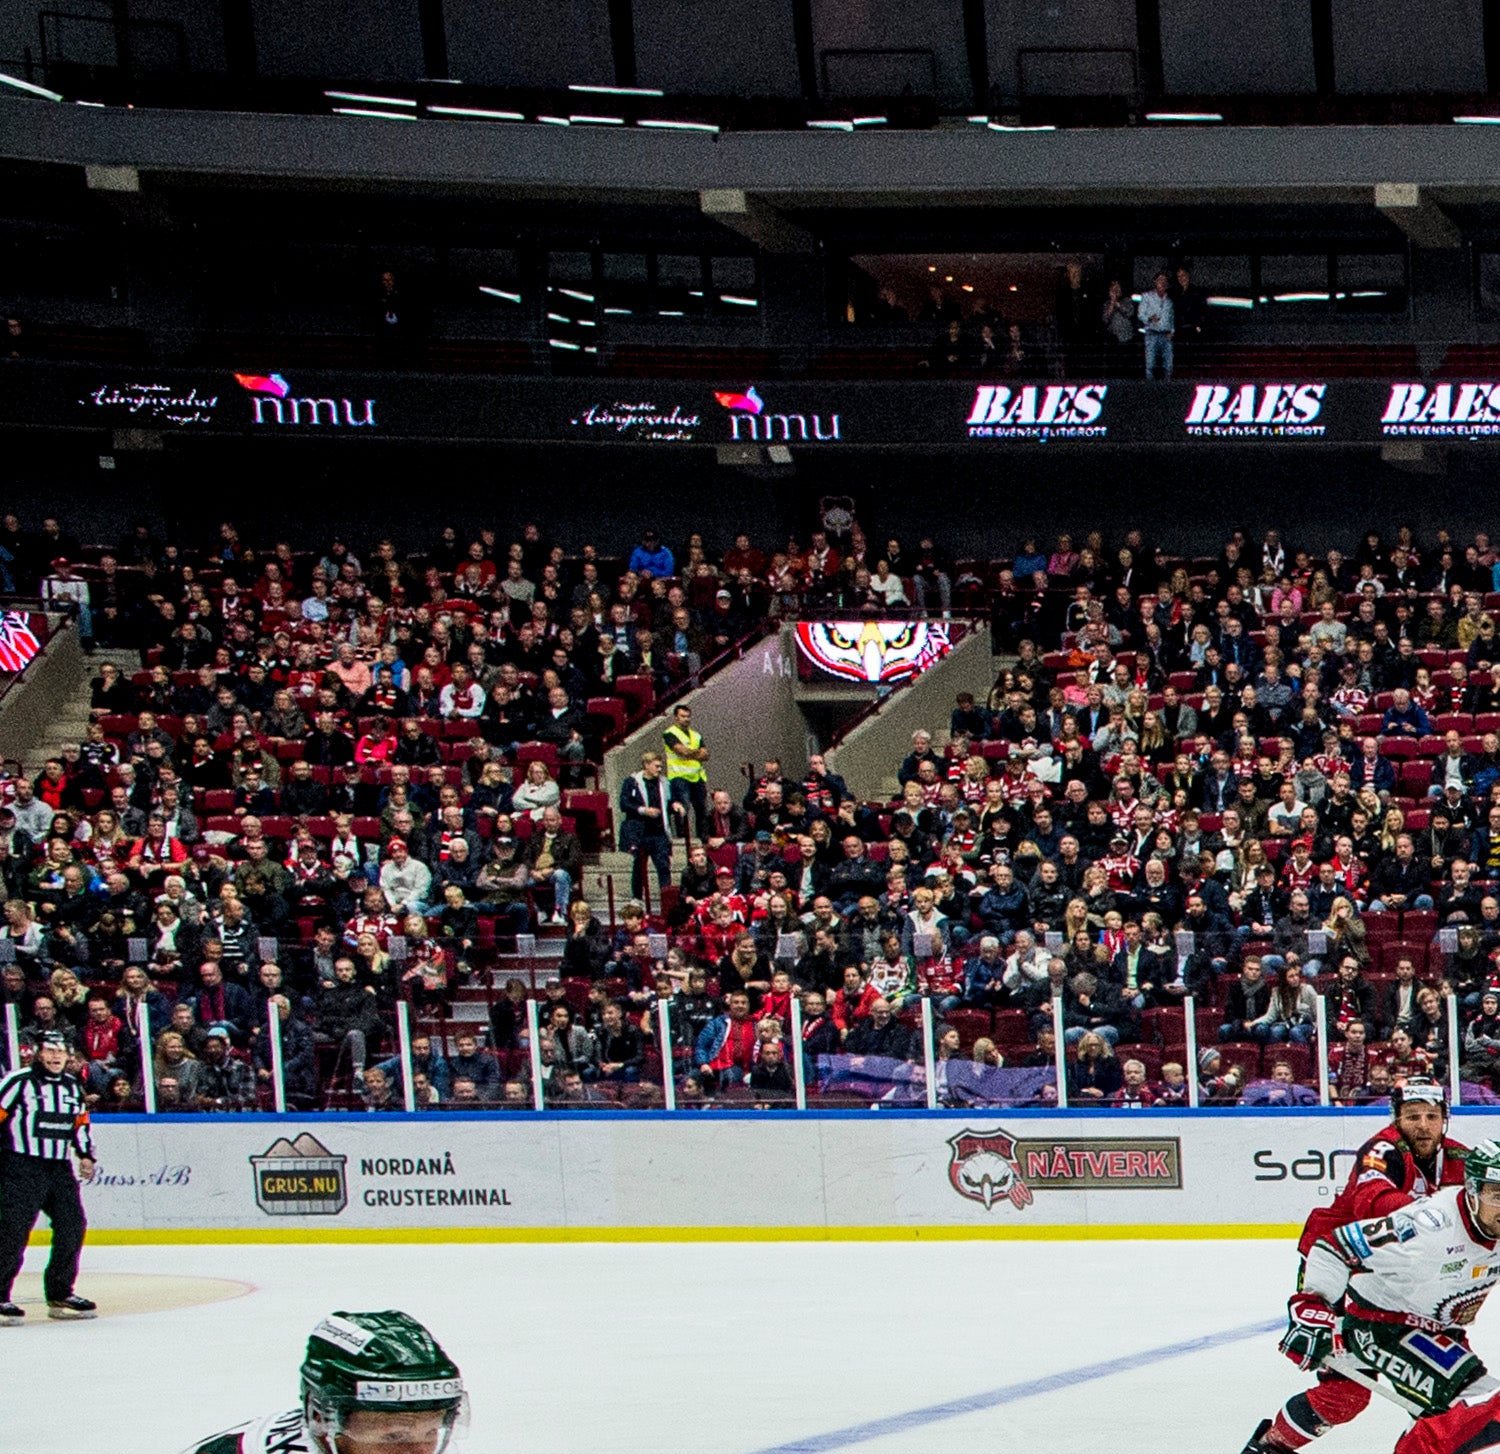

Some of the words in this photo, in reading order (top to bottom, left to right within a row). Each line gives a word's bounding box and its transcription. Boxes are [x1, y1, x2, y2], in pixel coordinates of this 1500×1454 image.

[361, 1151, 456, 1176] NORDANÅ
[1026, 1145, 1172, 1180] NÄTVERK
[263, 1175, 338, 1195] GRUS.NU
[364, 1188, 512, 1207] GRUSTERMINAL
[1300, 1308, 1337, 1322] BAU
[1363, 1344, 1435, 1398] STENA
